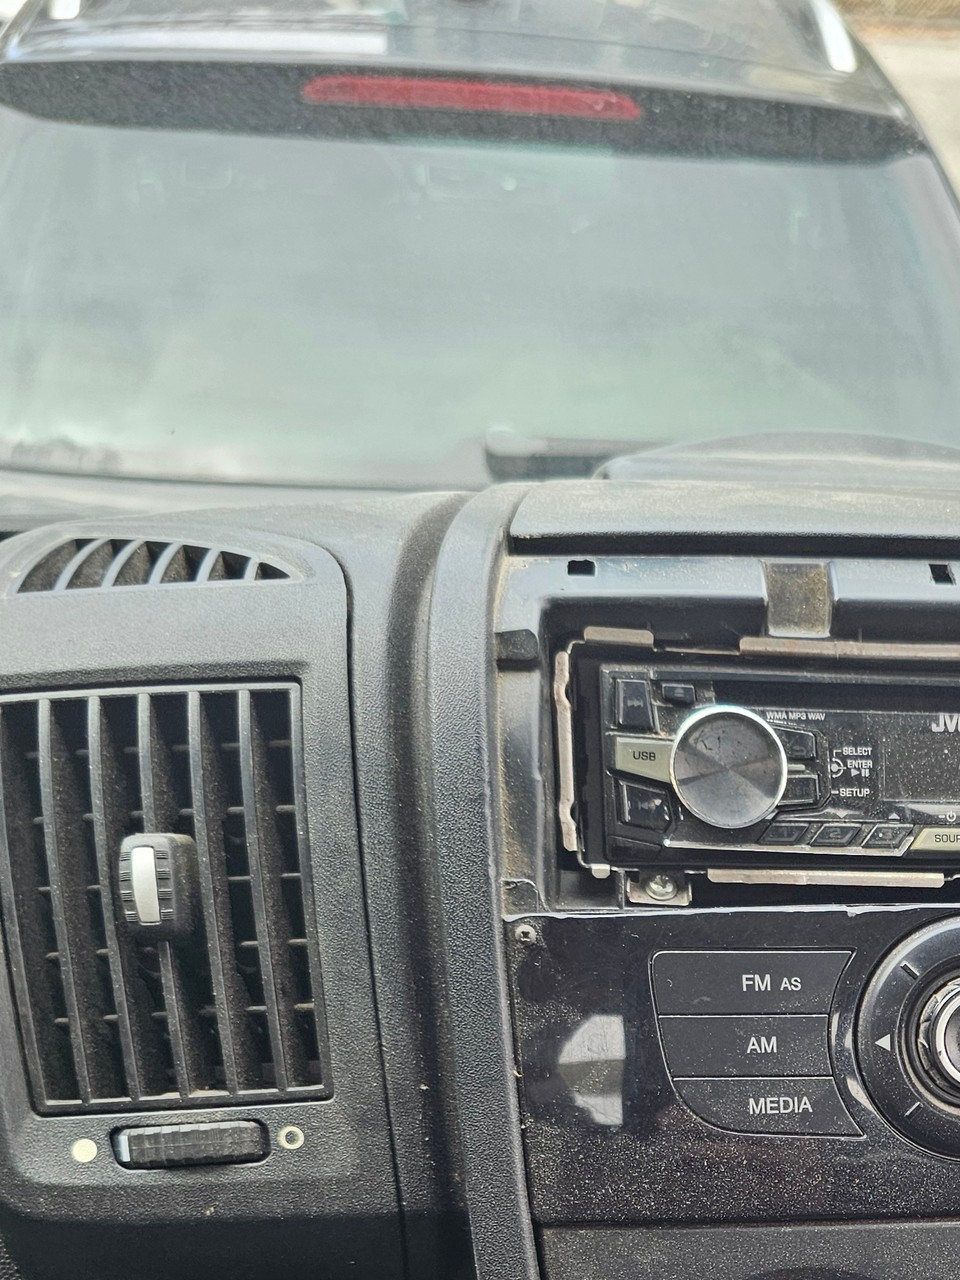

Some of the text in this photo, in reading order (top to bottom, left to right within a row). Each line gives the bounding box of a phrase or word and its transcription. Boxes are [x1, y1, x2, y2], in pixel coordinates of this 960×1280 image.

[766, 711, 826, 721] WMA MP3 WAV
[632, 751, 656, 761] USB
[842, 747, 873, 756] SELECT
[847, 760, 873, 768] ENTER
[839, 787, 871, 797] SETUP
[829, 827, 841, 838] 2
[741, 974, 802, 991] FM AS
[746, 1036, 778, 1054] AM
[748, 1096, 814, 1115] MEDIA
